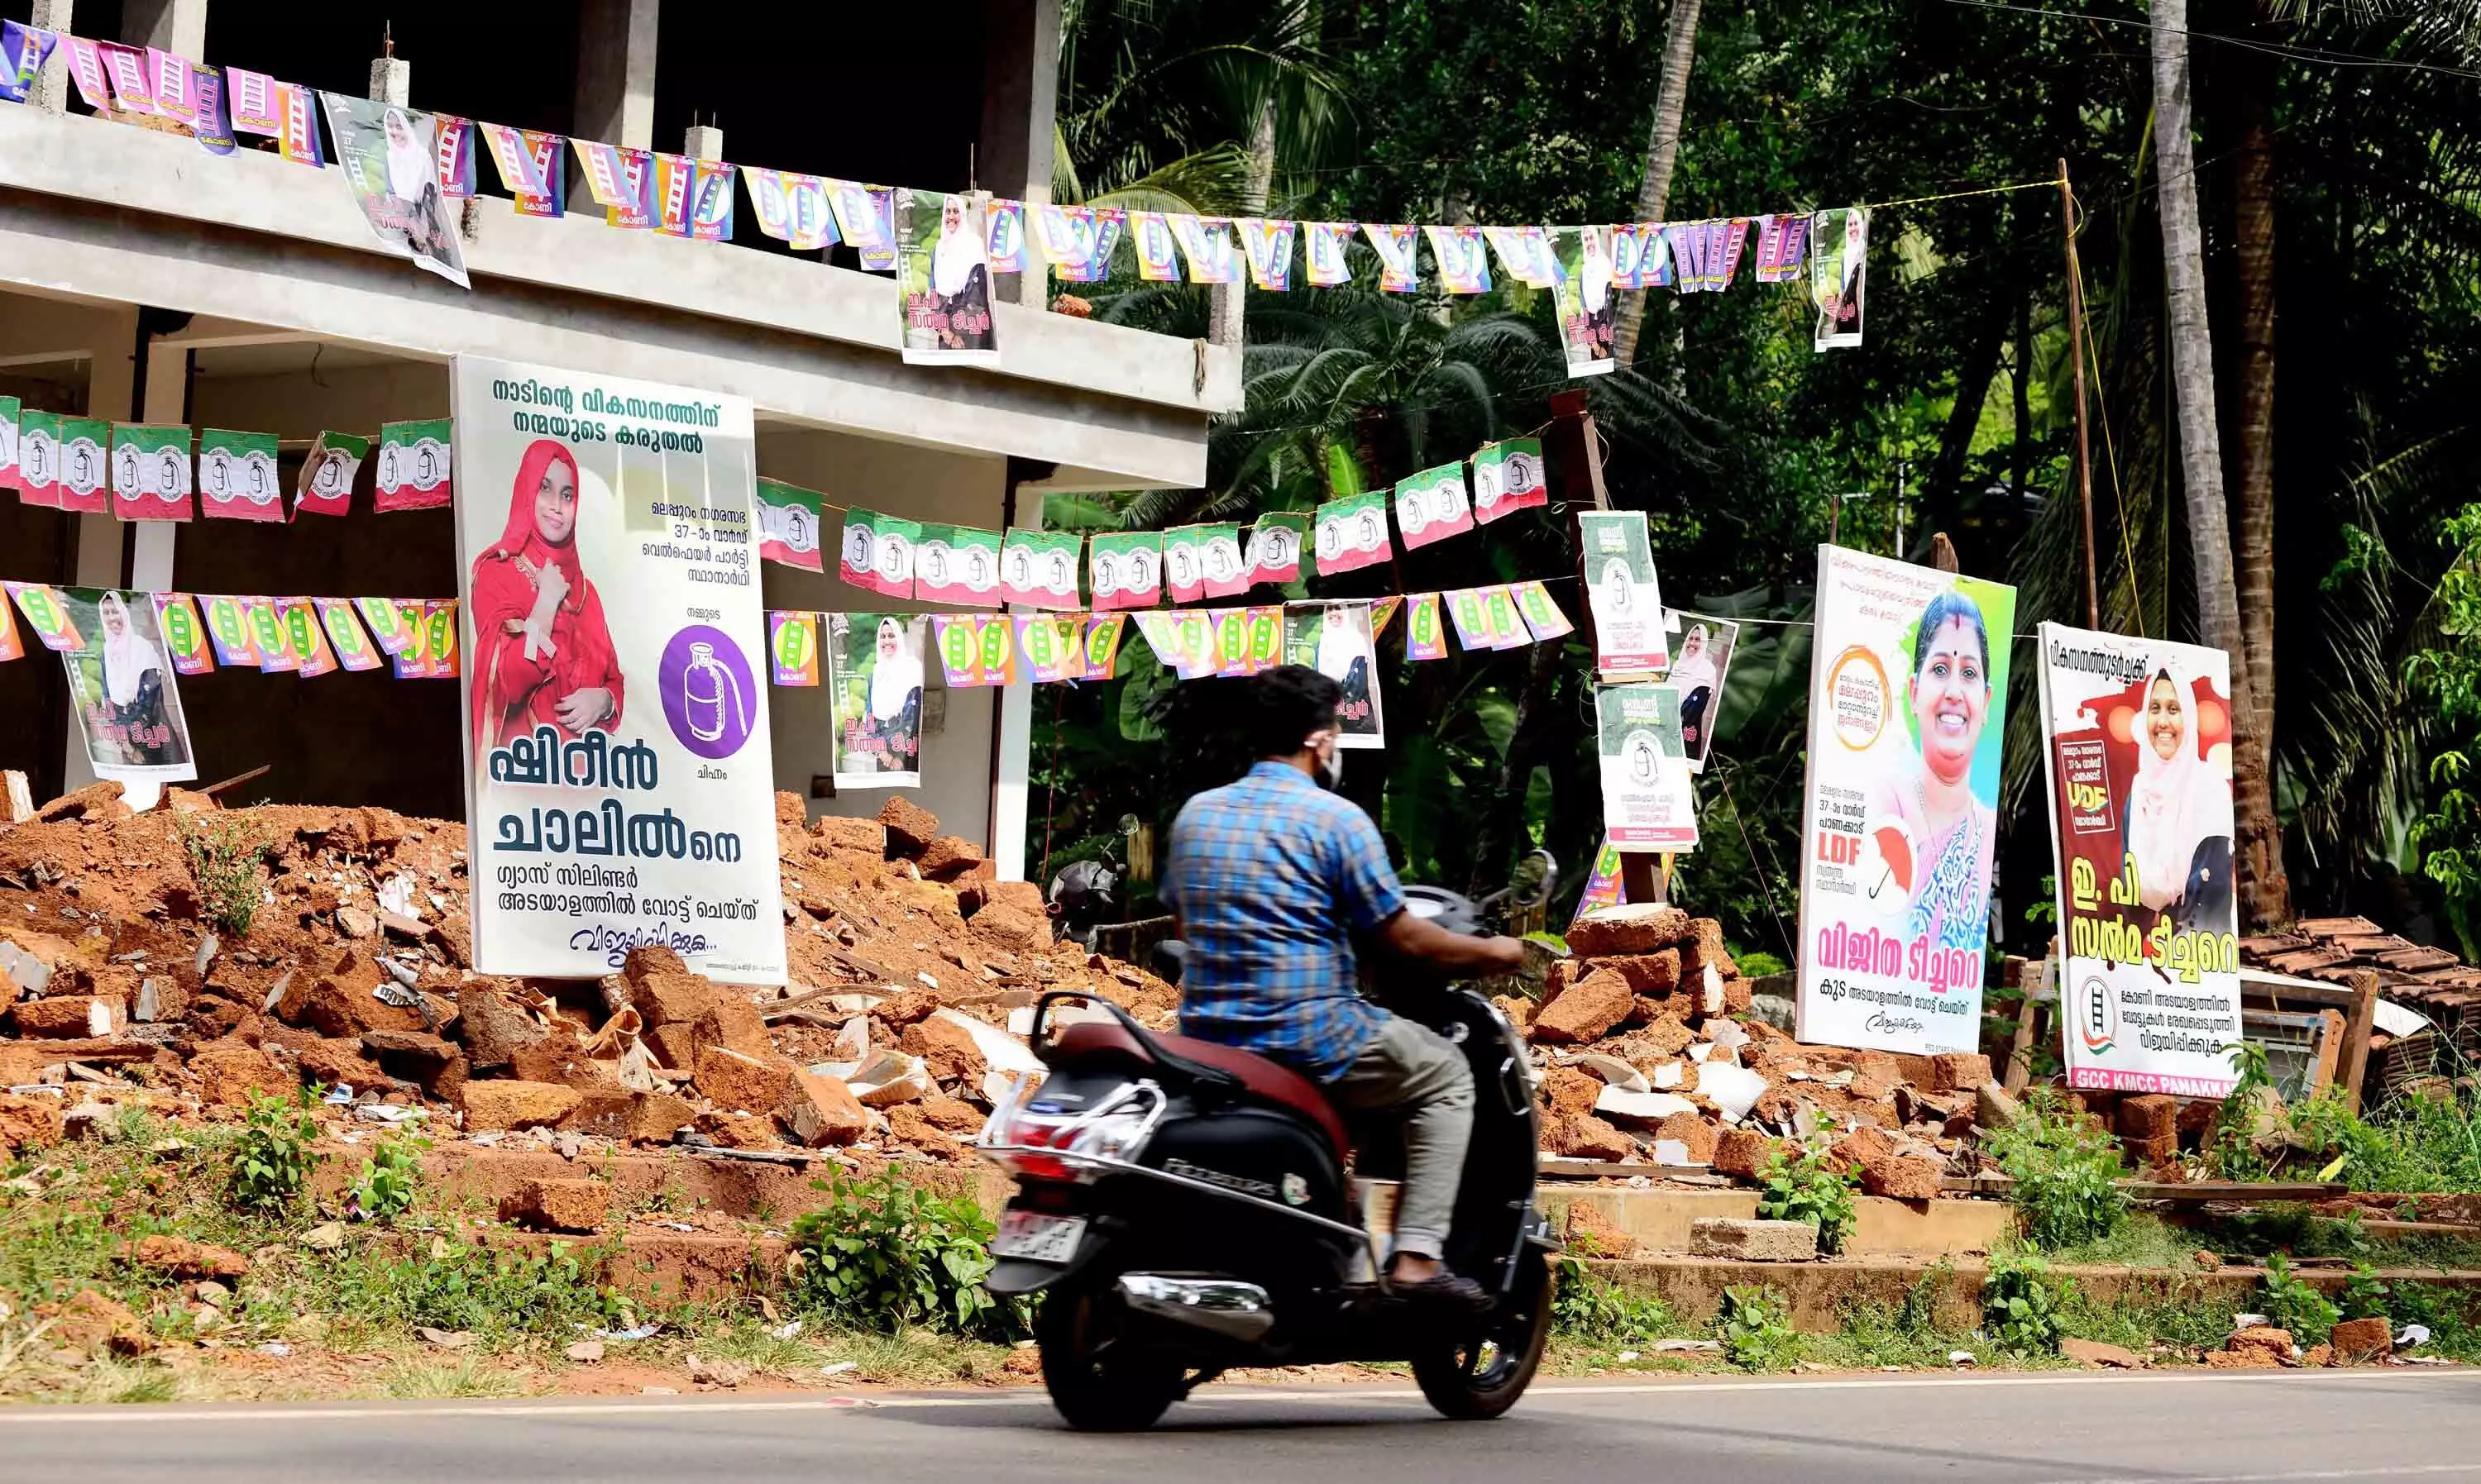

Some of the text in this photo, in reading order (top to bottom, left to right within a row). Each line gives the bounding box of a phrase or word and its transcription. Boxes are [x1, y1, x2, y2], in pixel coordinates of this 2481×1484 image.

[492, 379, 722, 428] നാടിന്റെ വികസനത്തിന്
[513, 410, 703, 455] നന്മയുടെ കരുതൽ
[652, 502, 747, 524] മലപ്പുറം നഗരസഭ
[714, 529, 748, 544] വാർഡ്
[642, 542, 749, 570] വെൽഫെയർ പാർട്ടി
[686, 606, 721, 622] നമ്മുടെ
[1838, 685, 1879, 704] മലപ്പുറം
[490, 725, 658, 791] ഷിറീൻ
[697, 765, 728, 781] ചിഹ്നം
[2066, 780, 2108, 809] UDF
[1819, 818, 1865, 835] പാണക്കാട്
[1818, 831, 1862, 866] LDF
[496, 861, 638, 890] ഗ്യാസ് സിലിണ്ടർ
[498, 890, 760, 923] അടയാളത്തിൽ വോട്ട് ചെയ്ത്
[1818, 920, 1980, 994] വിജിത ടീച്ചറെ
[2071, 913, 2239, 984] സൽമ ടീച്ചറെ
[1819, 978, 1971, 1017] കുട അടയാളത്തിൽ വോട്ട് ചെയ്ത്
[2120, 990, 2230, 1013] കോണി അടയാളത്തിൽ
[2121, 1009, 2235, 1034] വോട്ടുകൾ രേഖപ്പെടുത്തി
[2139, 1030, 2223, 1058] വിജയിപ്പിക്കുക
[2076, 1069, 2110, 1088] GCC
[2114, 1073, 2159, 1093] KMCC
